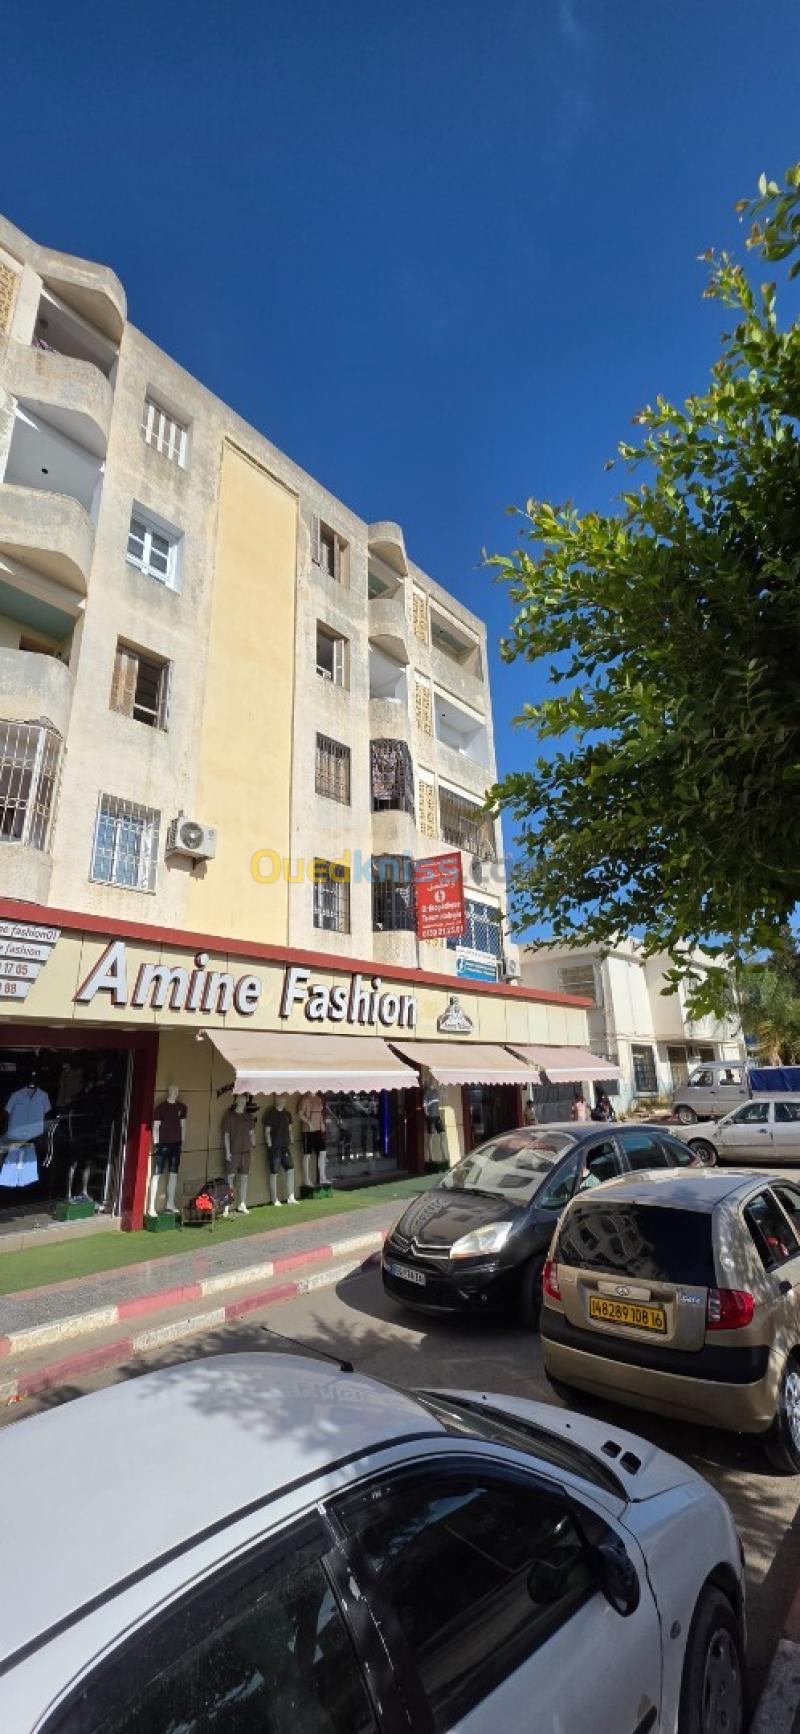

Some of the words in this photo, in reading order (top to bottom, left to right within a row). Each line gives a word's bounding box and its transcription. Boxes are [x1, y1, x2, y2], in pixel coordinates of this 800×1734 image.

[5, 943, 40, 956] fashion
[15, 964, 28, 975] 05
[72, 940, 262, 1016] Amine
[280, 966, 417, 1028] Fashion
[592, 1299, 629, 1317] 148289
[631, 1307, 648, 1323] 108
[651, 1312, 663, 1328] 16
